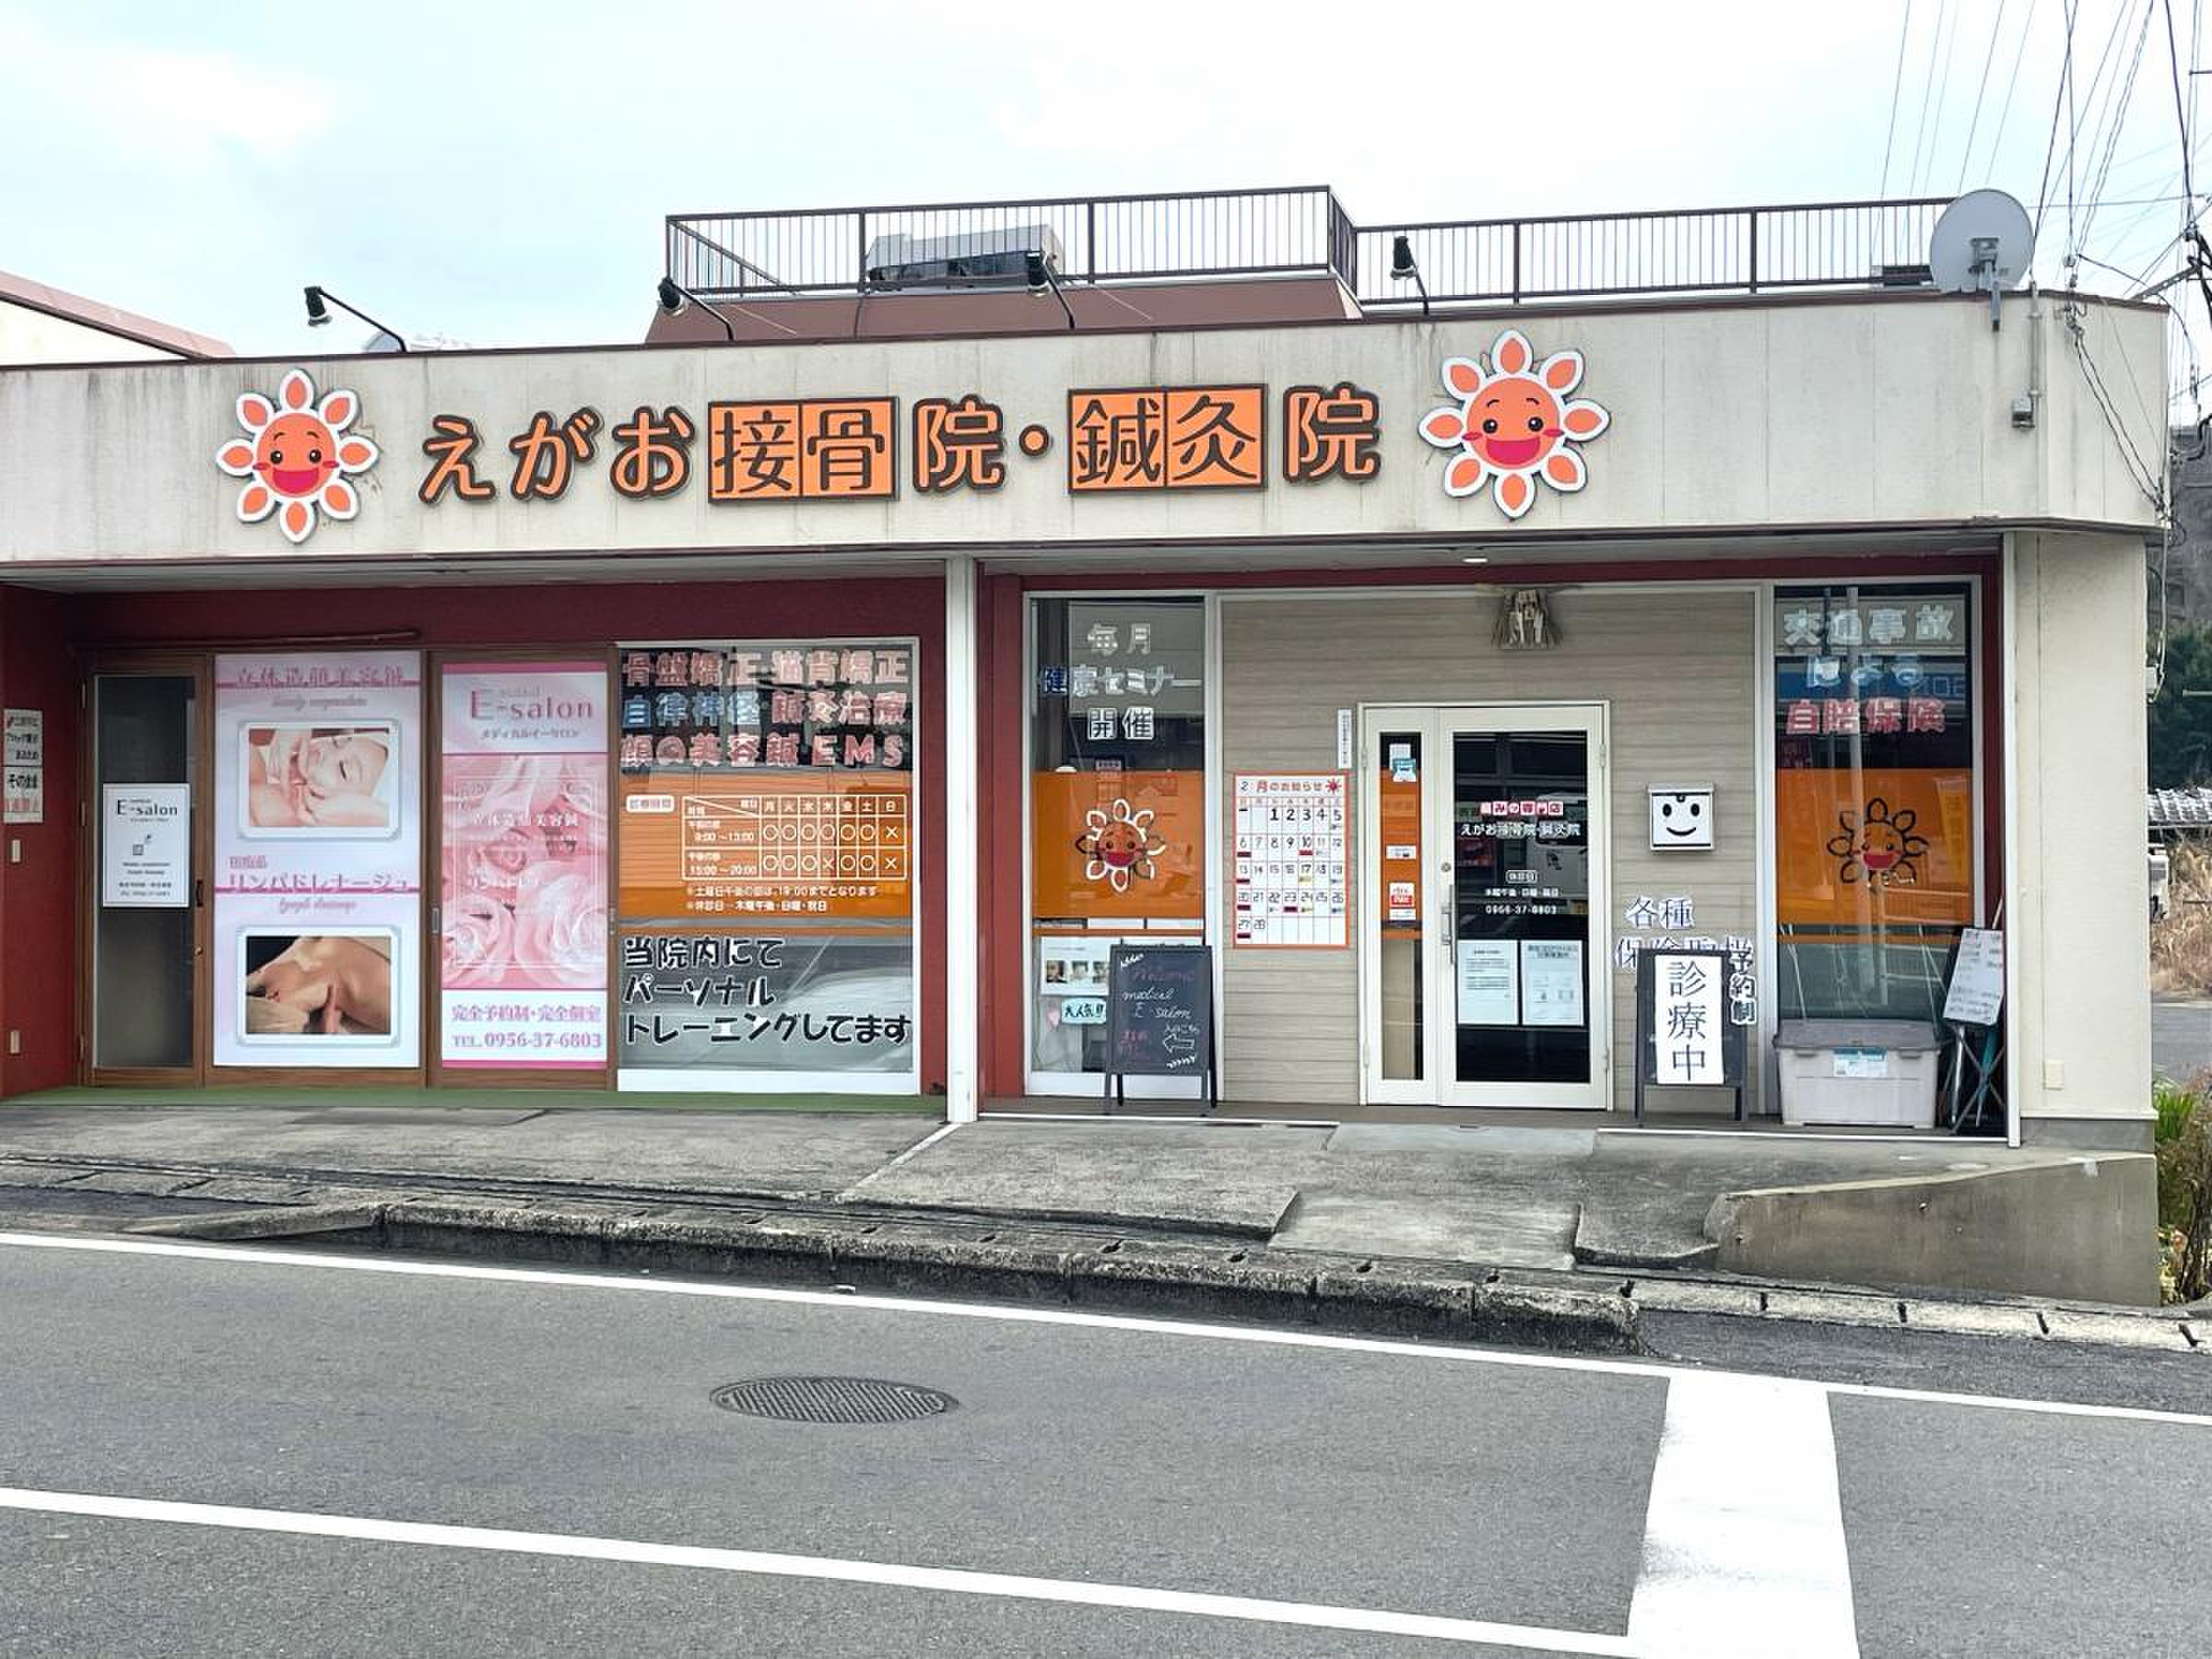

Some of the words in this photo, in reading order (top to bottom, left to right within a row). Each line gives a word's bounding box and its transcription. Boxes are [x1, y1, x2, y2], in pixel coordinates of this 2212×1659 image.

[418, 381, 1382, 504] えがお接骨院・鍼灸院
[1087, 623, 1151, 655] 毎月
[1783, 605, 1954, 645] 交通事故
[1040, 664, 1203, 697] 健康セミナー
[471, 689, 594, 720] E-salon
[1785, 697, 1946, 735] 自賠保険
[1087, 706, 1155, 740] 開催
[811, 735, 904, 768] EMS
[117, 799, 178, 816] E-salon
[862, 801, 873, 812] 土
[886, 801, 896, 812] 日
[1626, 895, 1696, 930] 各種
[625, 935, 784, 969] 当院内にて
[625, 972, 776, 1006] パーソナル
[626, 1012, 912, 1045] トレーニングしてます
[1665, 959, 1708, 1083] 診療中
